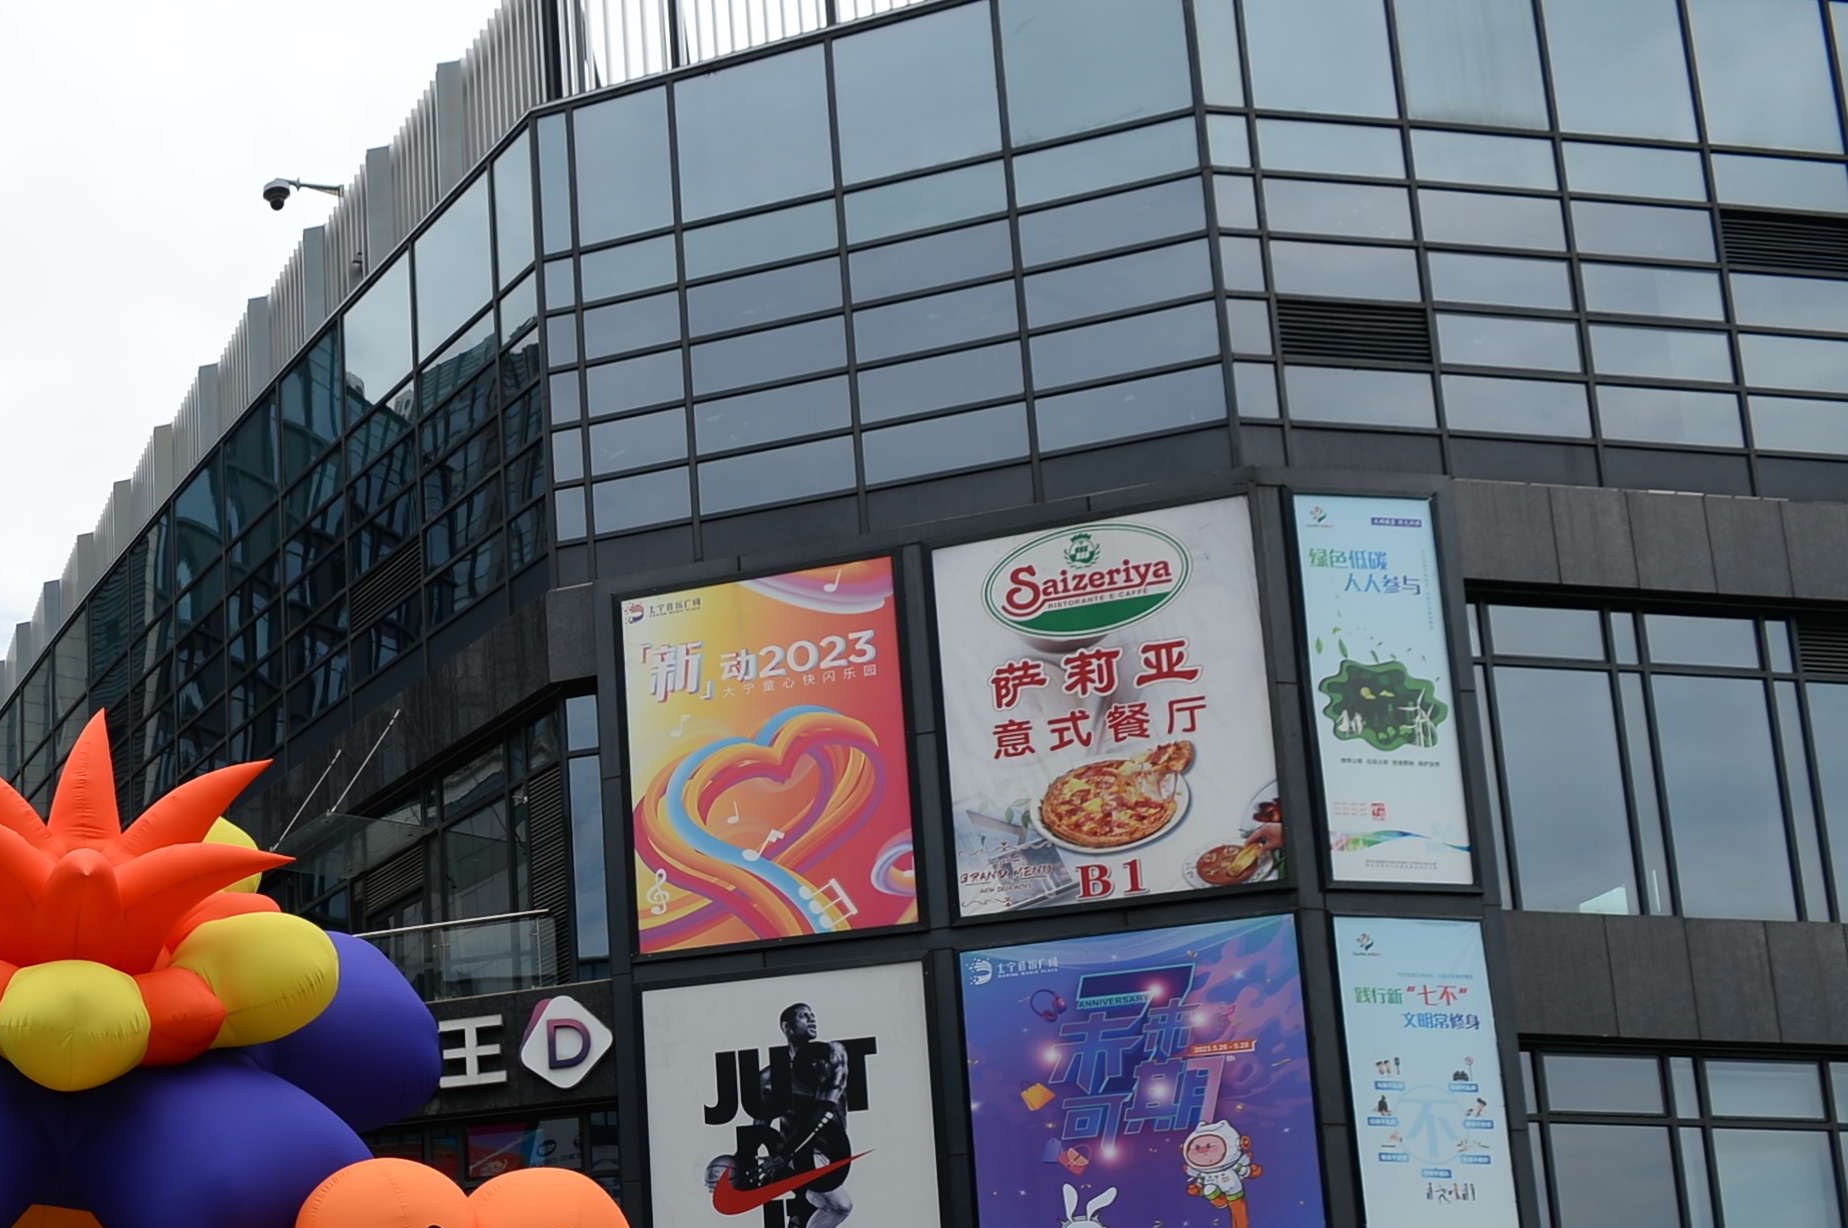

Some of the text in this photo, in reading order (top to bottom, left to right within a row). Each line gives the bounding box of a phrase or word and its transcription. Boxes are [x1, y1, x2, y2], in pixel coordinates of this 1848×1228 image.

[1309, 548, 1388, 570] 绿色低碳
[1004, 559, 1172, 612] Saizeriya
[1344, 572, 1421, 595] 人人参与
[1048, 595, 1105, 609] RISTORANTE
[723, 664, 878, 698] 大宁童心快闪乐园
[990, 640, 1199, 710] 萨莉亚
[992, 696, 1207, 760] 意式餐厅
[960, 868, 1008, 884] GRAND
[1078, 992, 1152, 1009] ANNIVERSARY
[1403, 1012, 1480, 1030] 文明常修身
[546, 1018, 592, 1070] D
